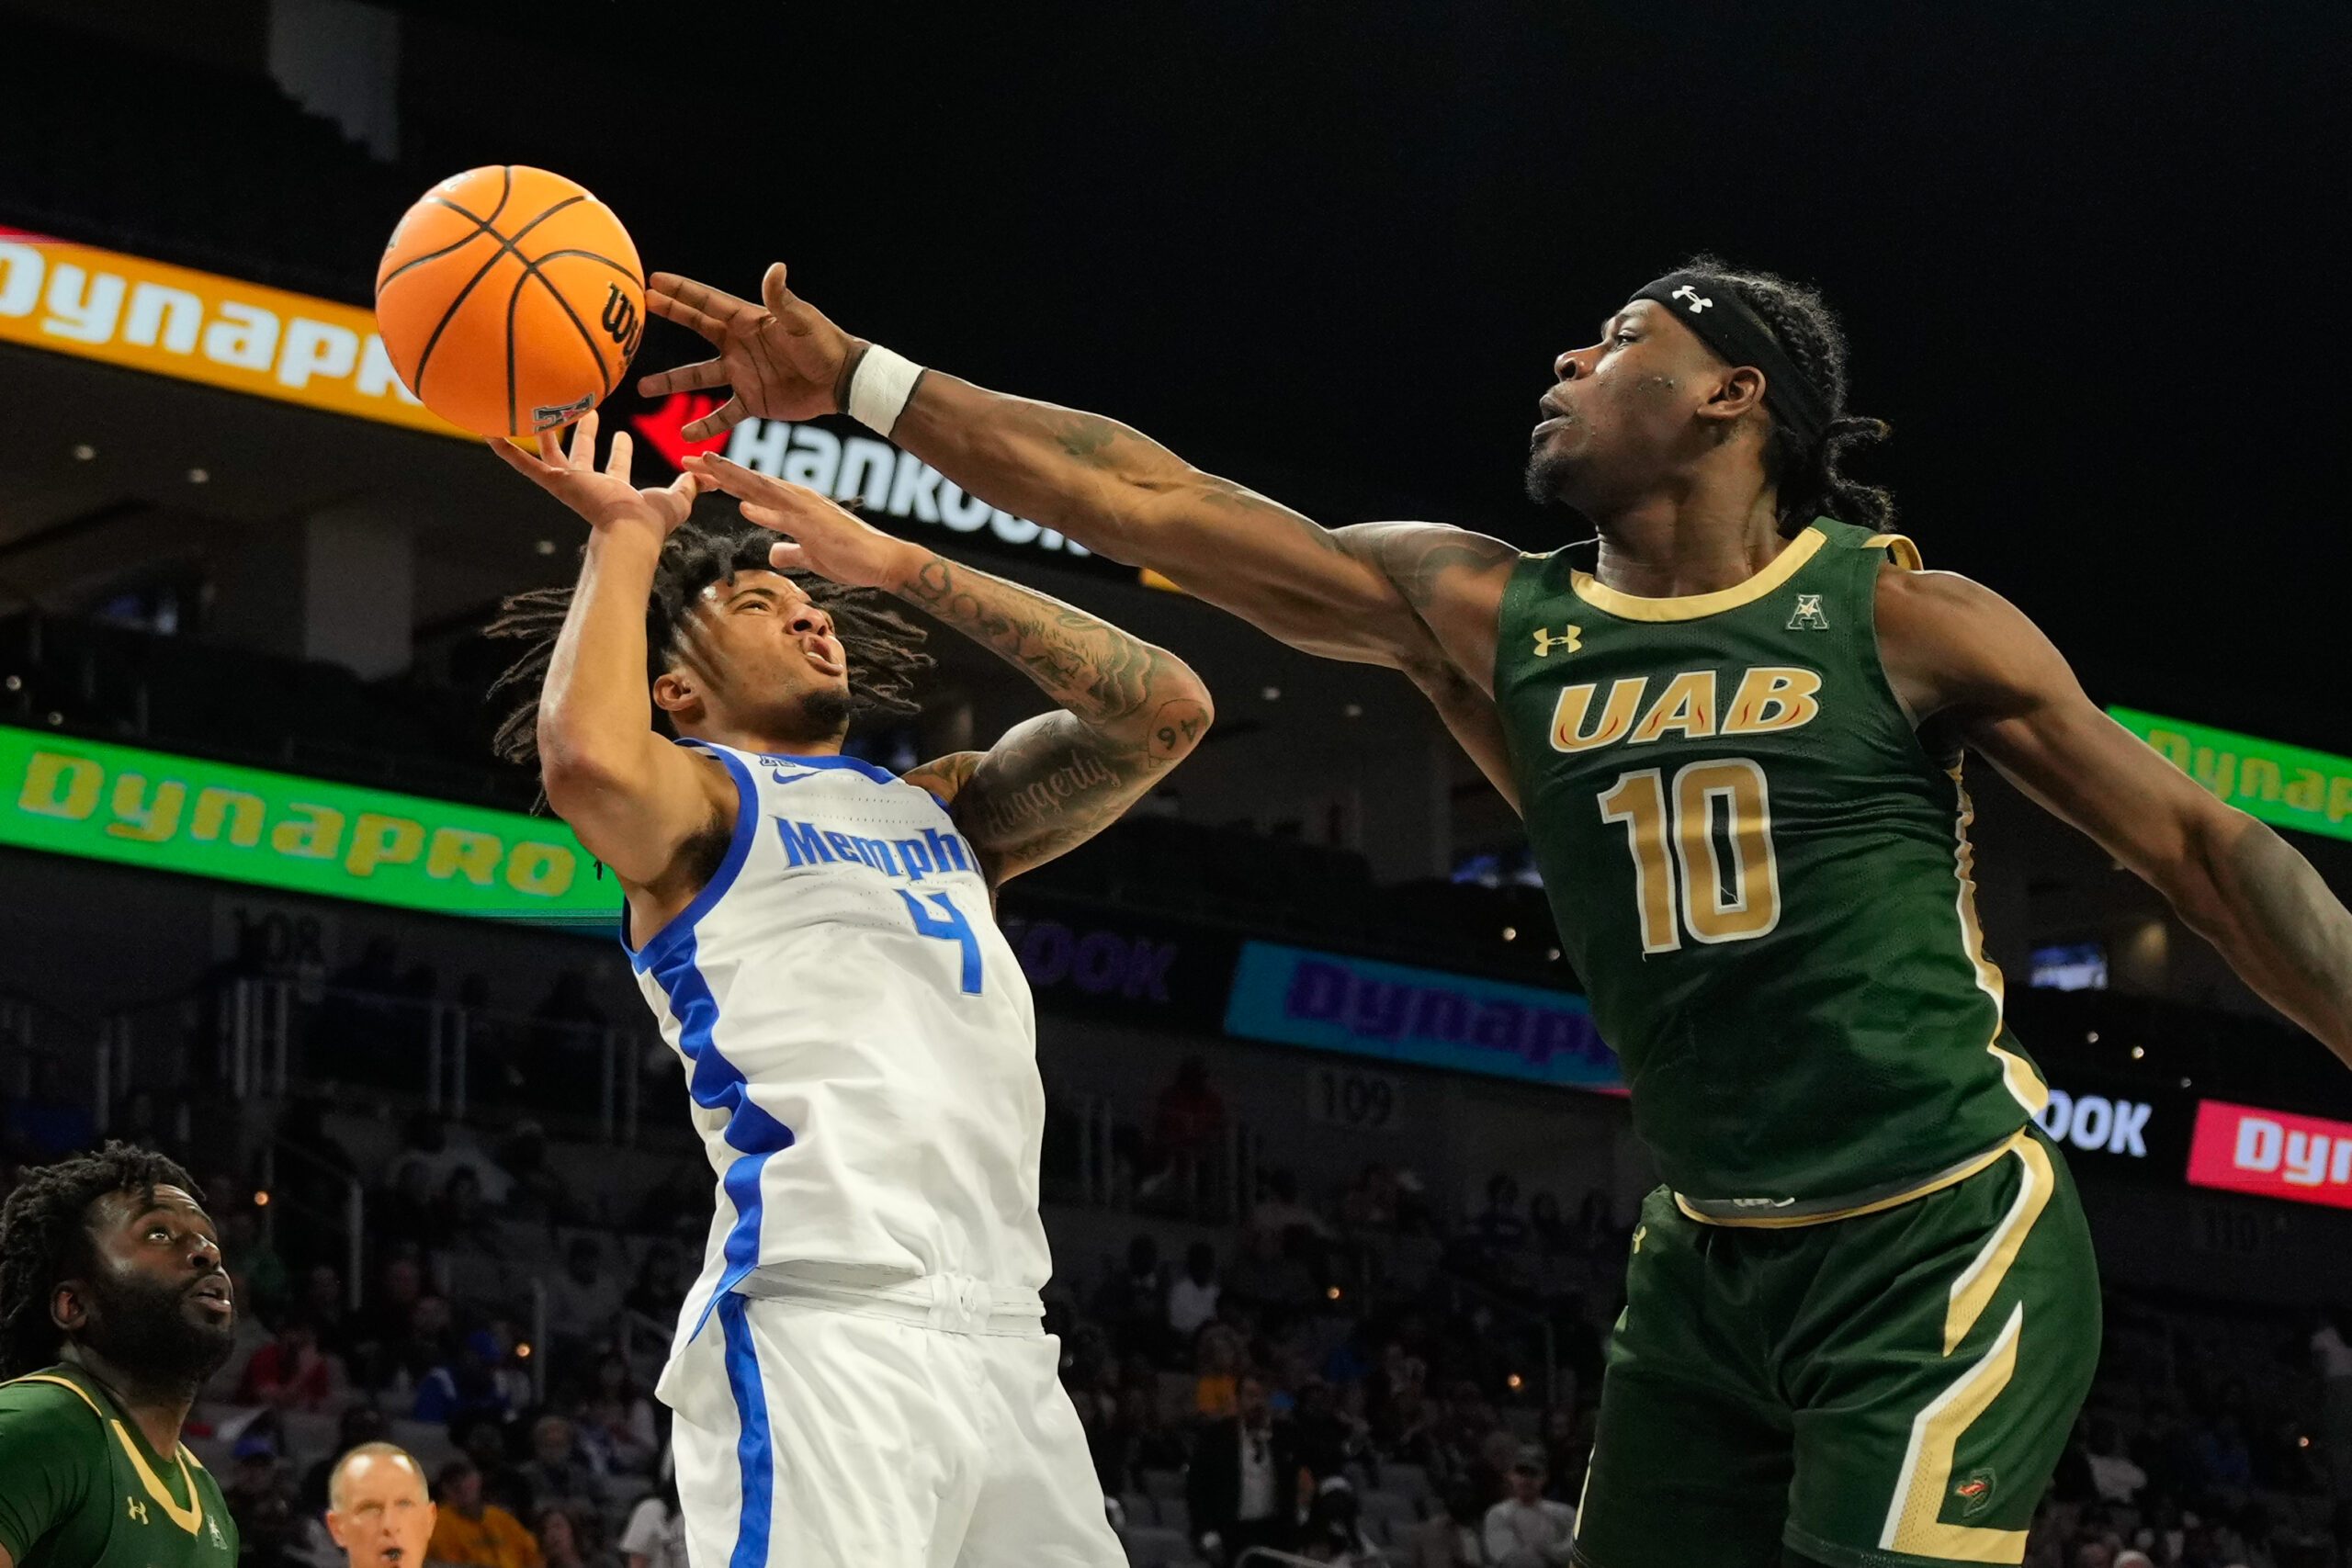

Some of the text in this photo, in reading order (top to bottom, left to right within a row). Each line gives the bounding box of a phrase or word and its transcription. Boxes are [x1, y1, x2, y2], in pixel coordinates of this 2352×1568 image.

[1550, 667, 1822, 753] UAB
[768, 814, 983, 881] Memph
[1597, 758, 1781, 953] 10
[894, 888, 982, 996] 4
[1323, 1073, 1394, 1128] 109
